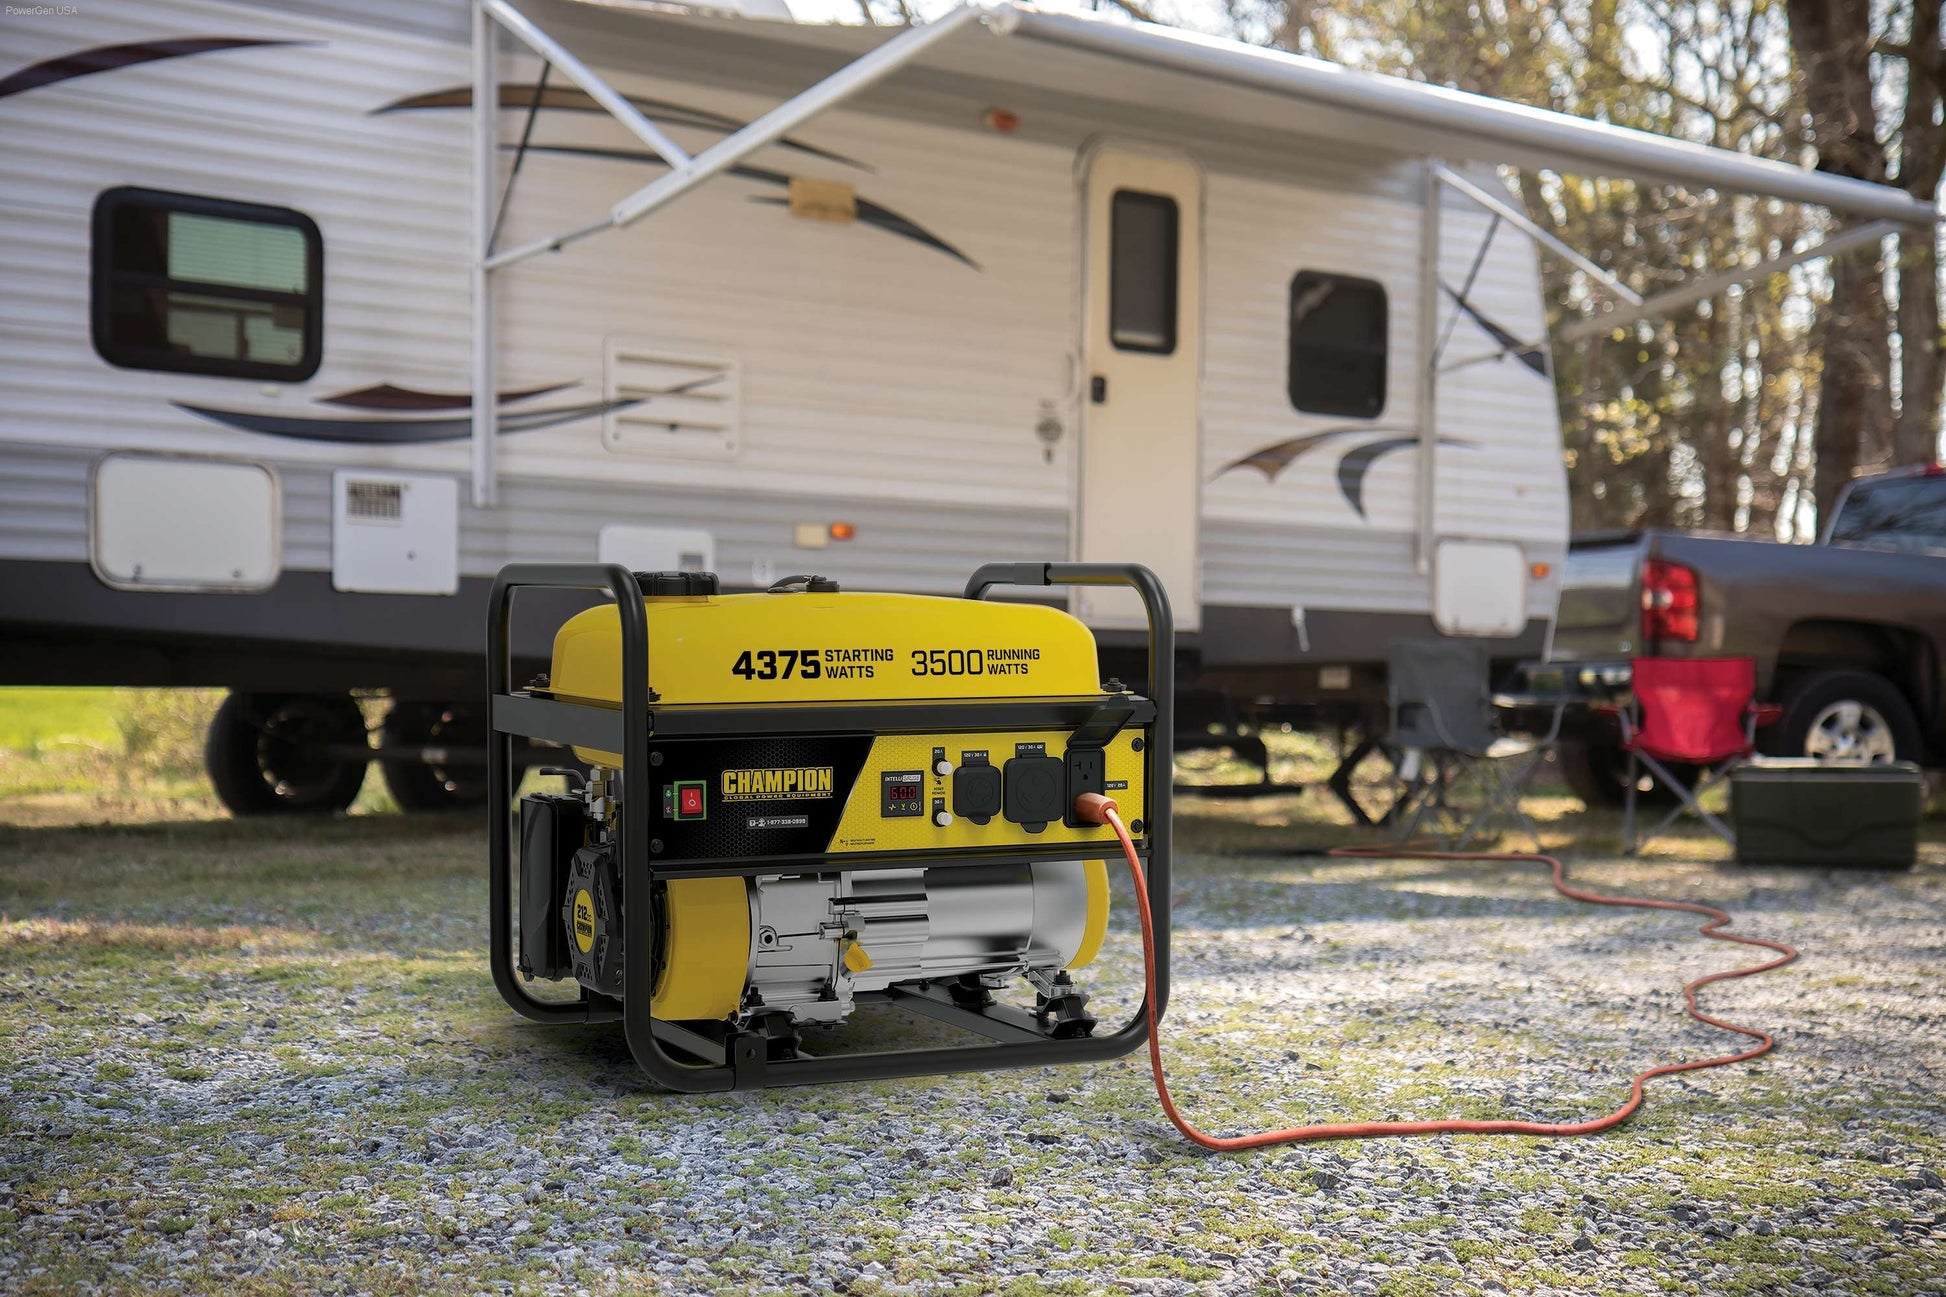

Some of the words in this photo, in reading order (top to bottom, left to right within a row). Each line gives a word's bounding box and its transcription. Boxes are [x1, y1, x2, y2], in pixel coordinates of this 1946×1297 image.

[824, 649, 894, 662] STARTING
[986, 649, 1040, 660] RUNNING
[731, 649, 820, 680] 4375
[911, 650, 983, 676] 3500
[986, 663, 1029, 675] WATTS
[826, 665, 875, 679] WATTS
[723, 768, 831, 794] CHAMPION
